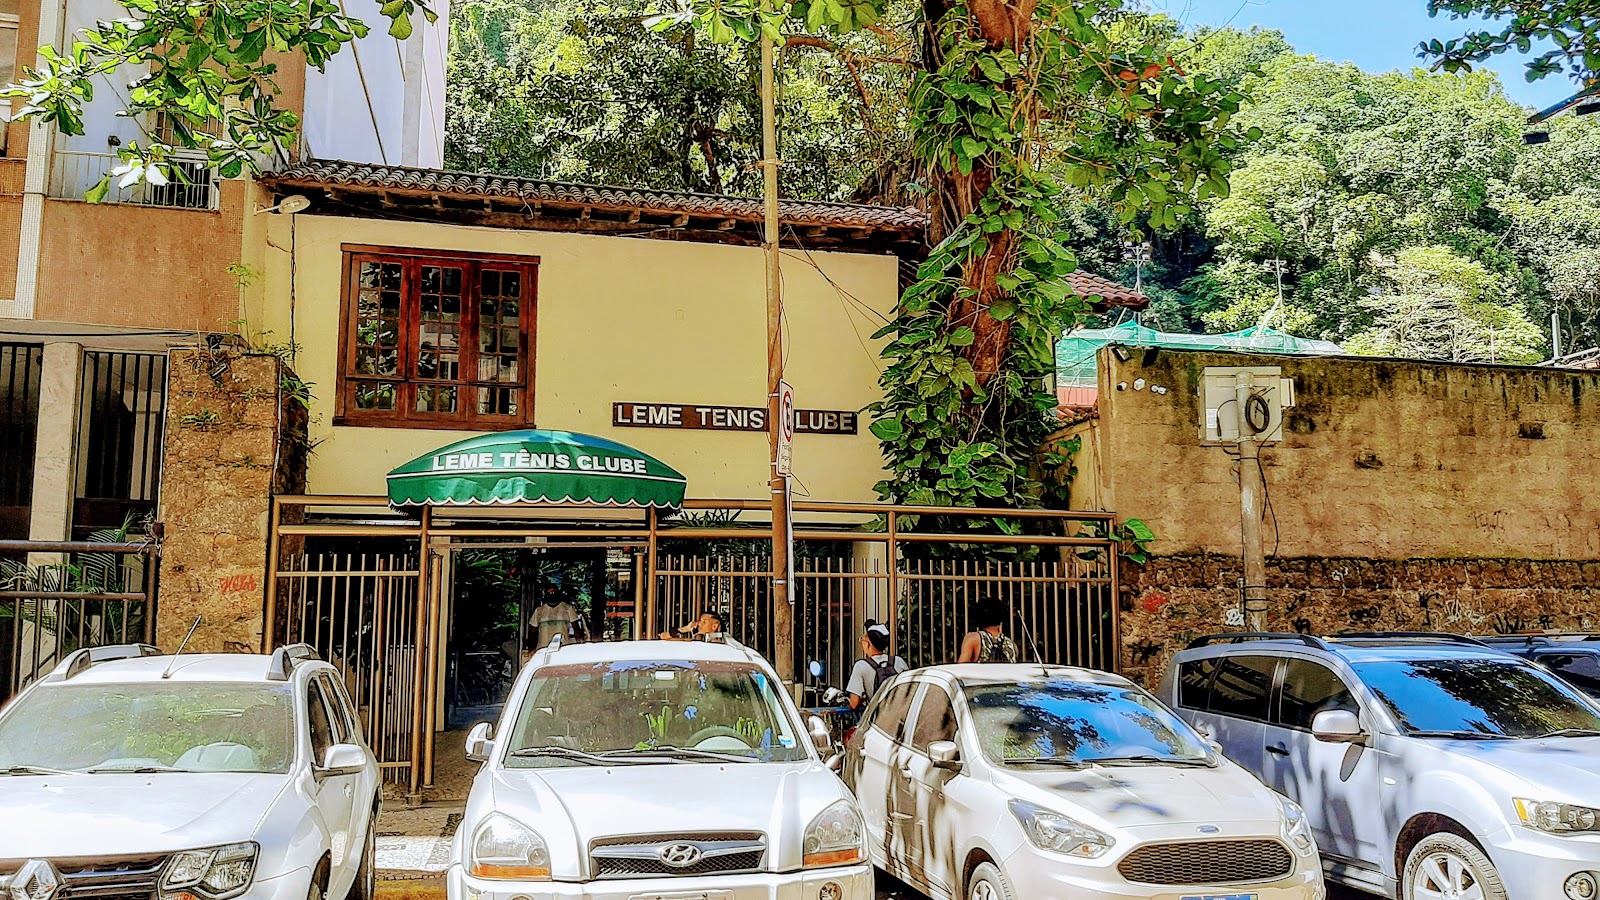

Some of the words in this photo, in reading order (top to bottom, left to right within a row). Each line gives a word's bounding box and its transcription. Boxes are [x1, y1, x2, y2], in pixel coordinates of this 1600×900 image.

[617, 404, 683, 426] LEME
[695, 407, 765, 429] TENIS
[790, 411, 854, 431] LUBE
[432, 452, 494, 471] LEME
[500, 448, 571, 469] TÊNIS
[576, 454, 648, 474] CLUBE
